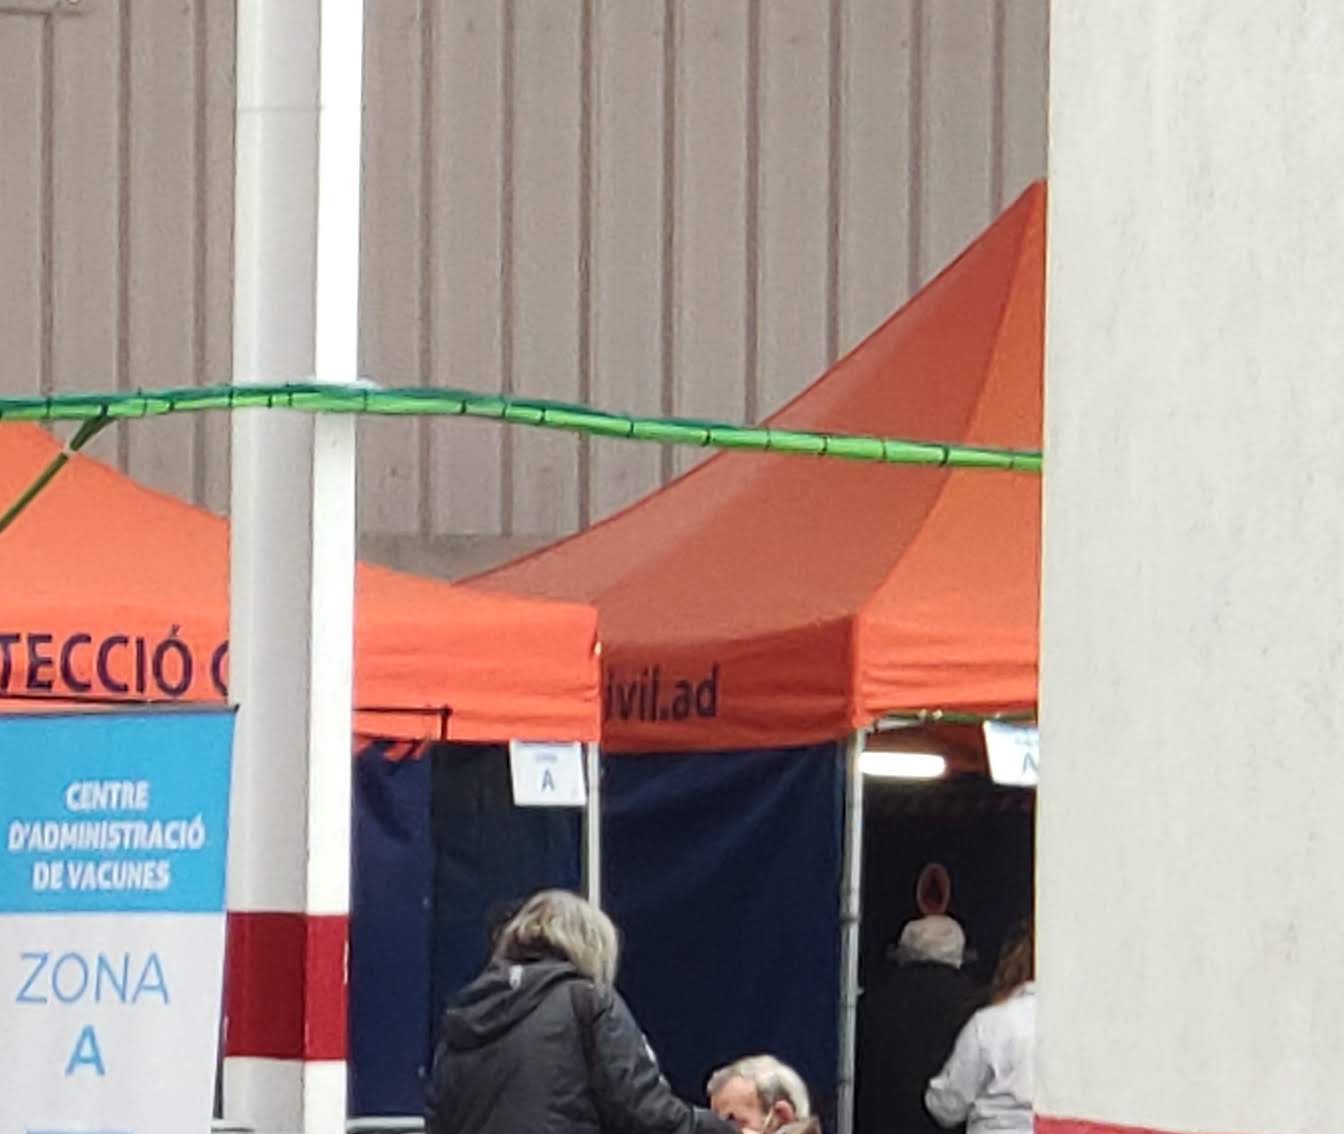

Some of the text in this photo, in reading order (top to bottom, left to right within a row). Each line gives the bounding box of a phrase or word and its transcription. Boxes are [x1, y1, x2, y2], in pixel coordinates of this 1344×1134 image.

[65, 779, 151, 812] CENTRE
[540, 766, 557, 793] A
[7, 814, 207, 851] D'ADMINISTRACIÓ
[32, 859, 172, 891] DE VACUNES
[15, 951, 171, 1005] ZONA
[64, 1023, 106, 1077] A
